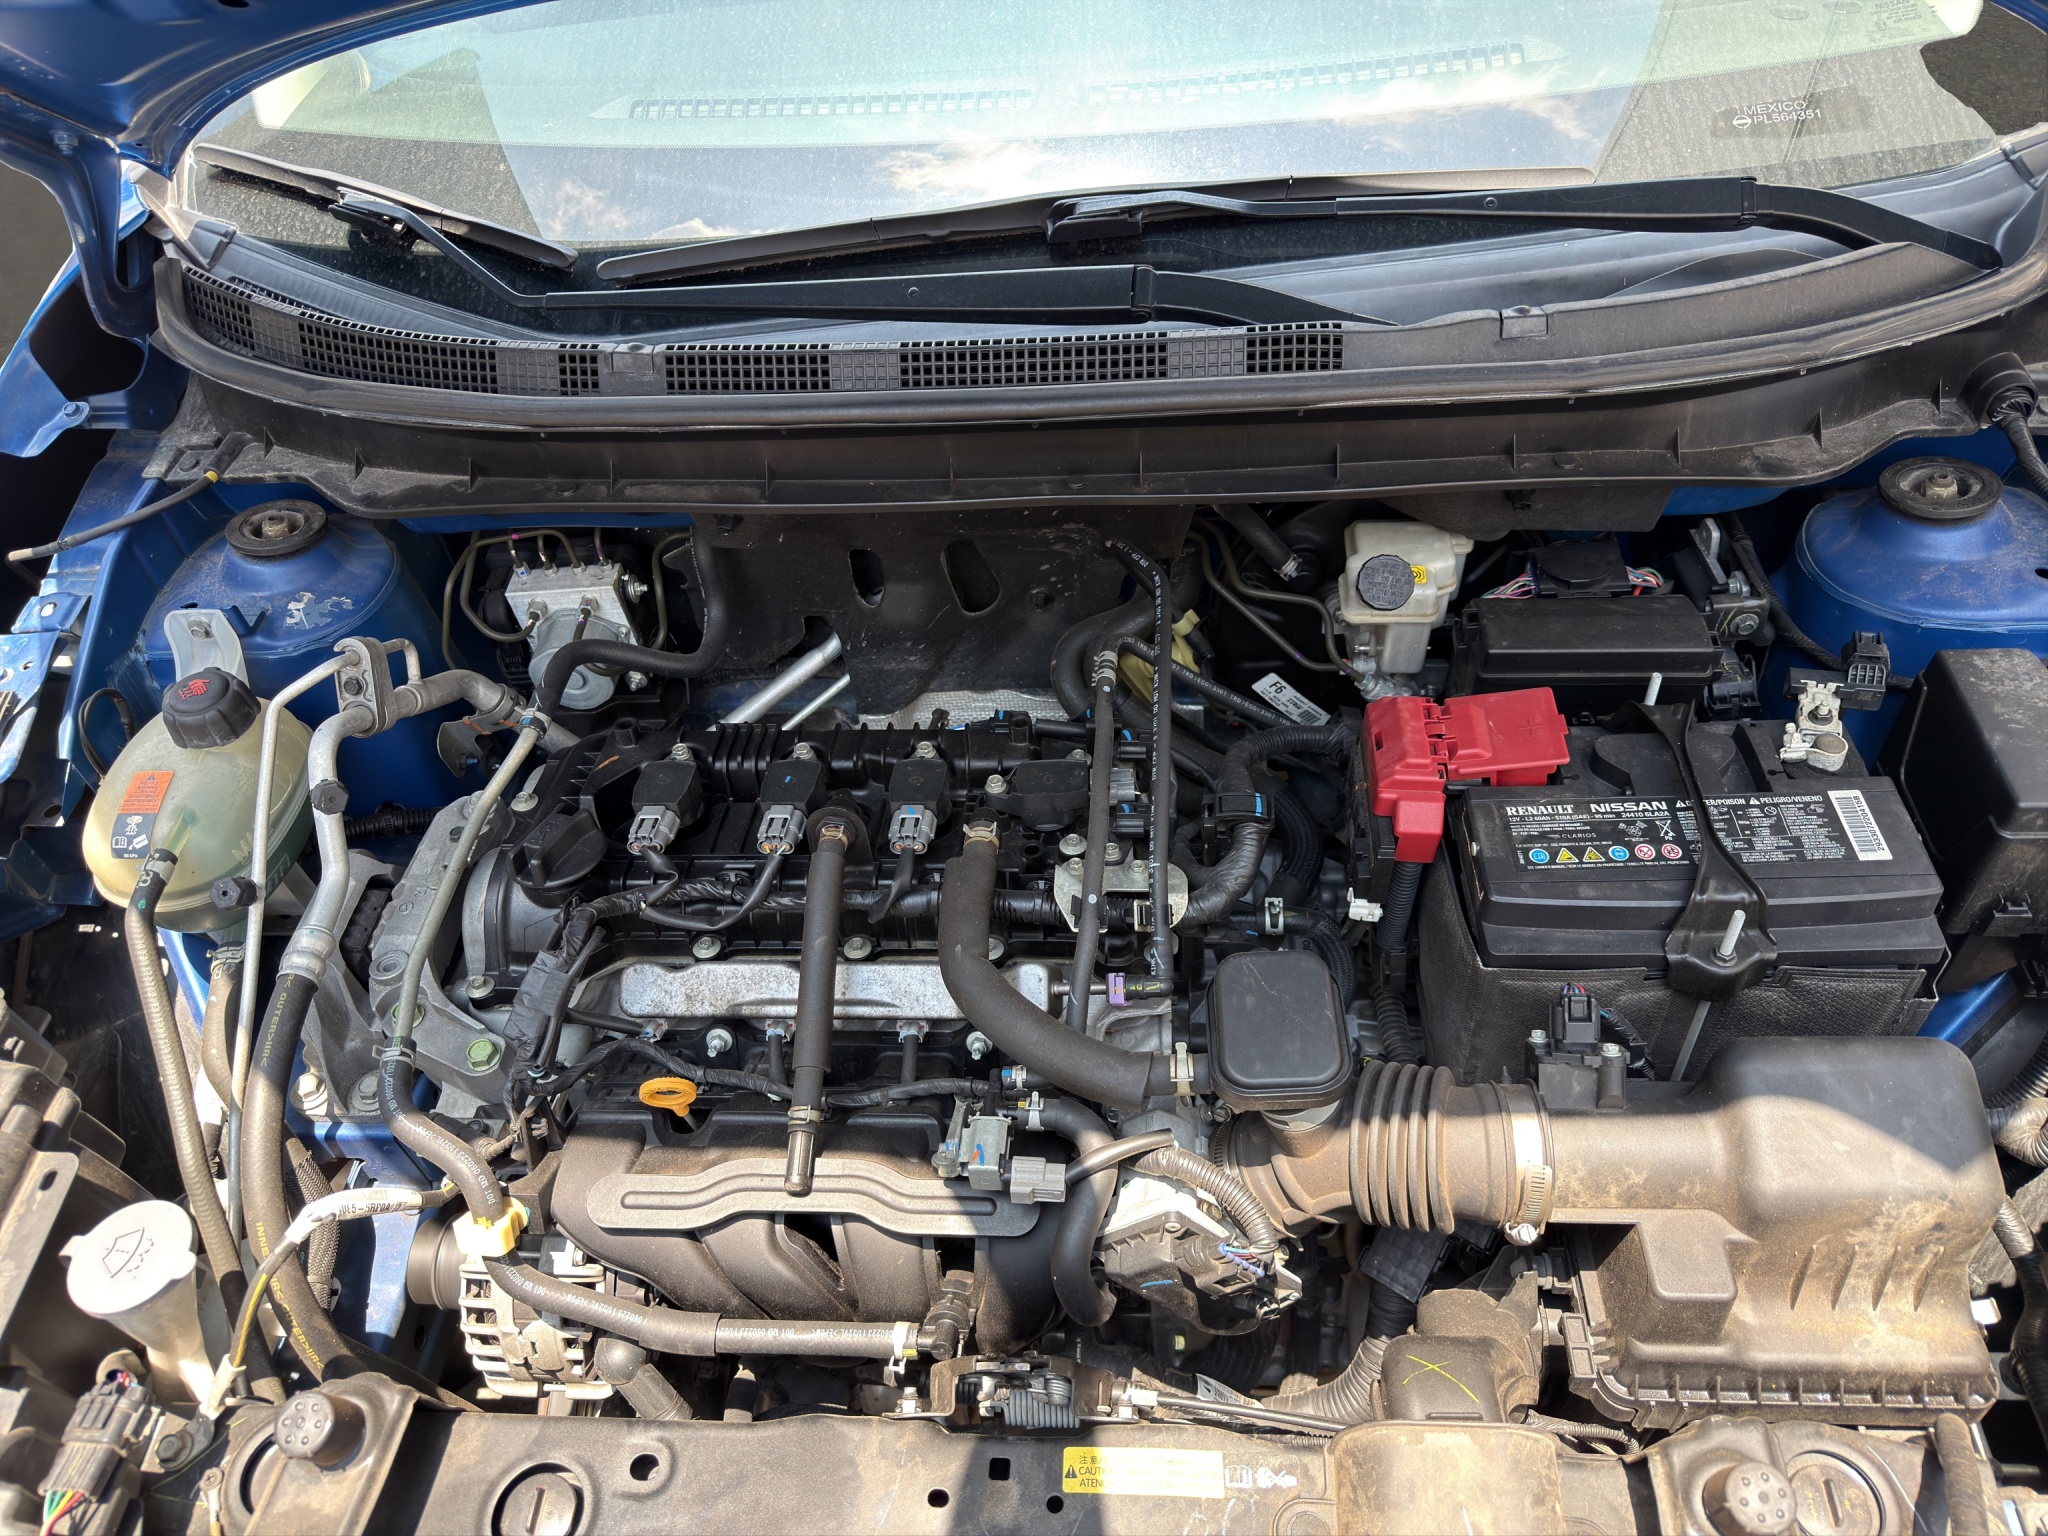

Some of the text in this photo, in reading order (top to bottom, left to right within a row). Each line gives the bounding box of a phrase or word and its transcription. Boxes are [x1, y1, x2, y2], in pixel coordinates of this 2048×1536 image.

[1743, 100, 1806, 115] MEXICO
[1753, 108, 1822, 125] PL564351
[1269, 681, 1287, 694] F6
[1505, 800, 1669, 816] RENAULT NISSAN
[457, 1151, 480, 1175] 060223
[484, 1186, 496, 1205] DOT
